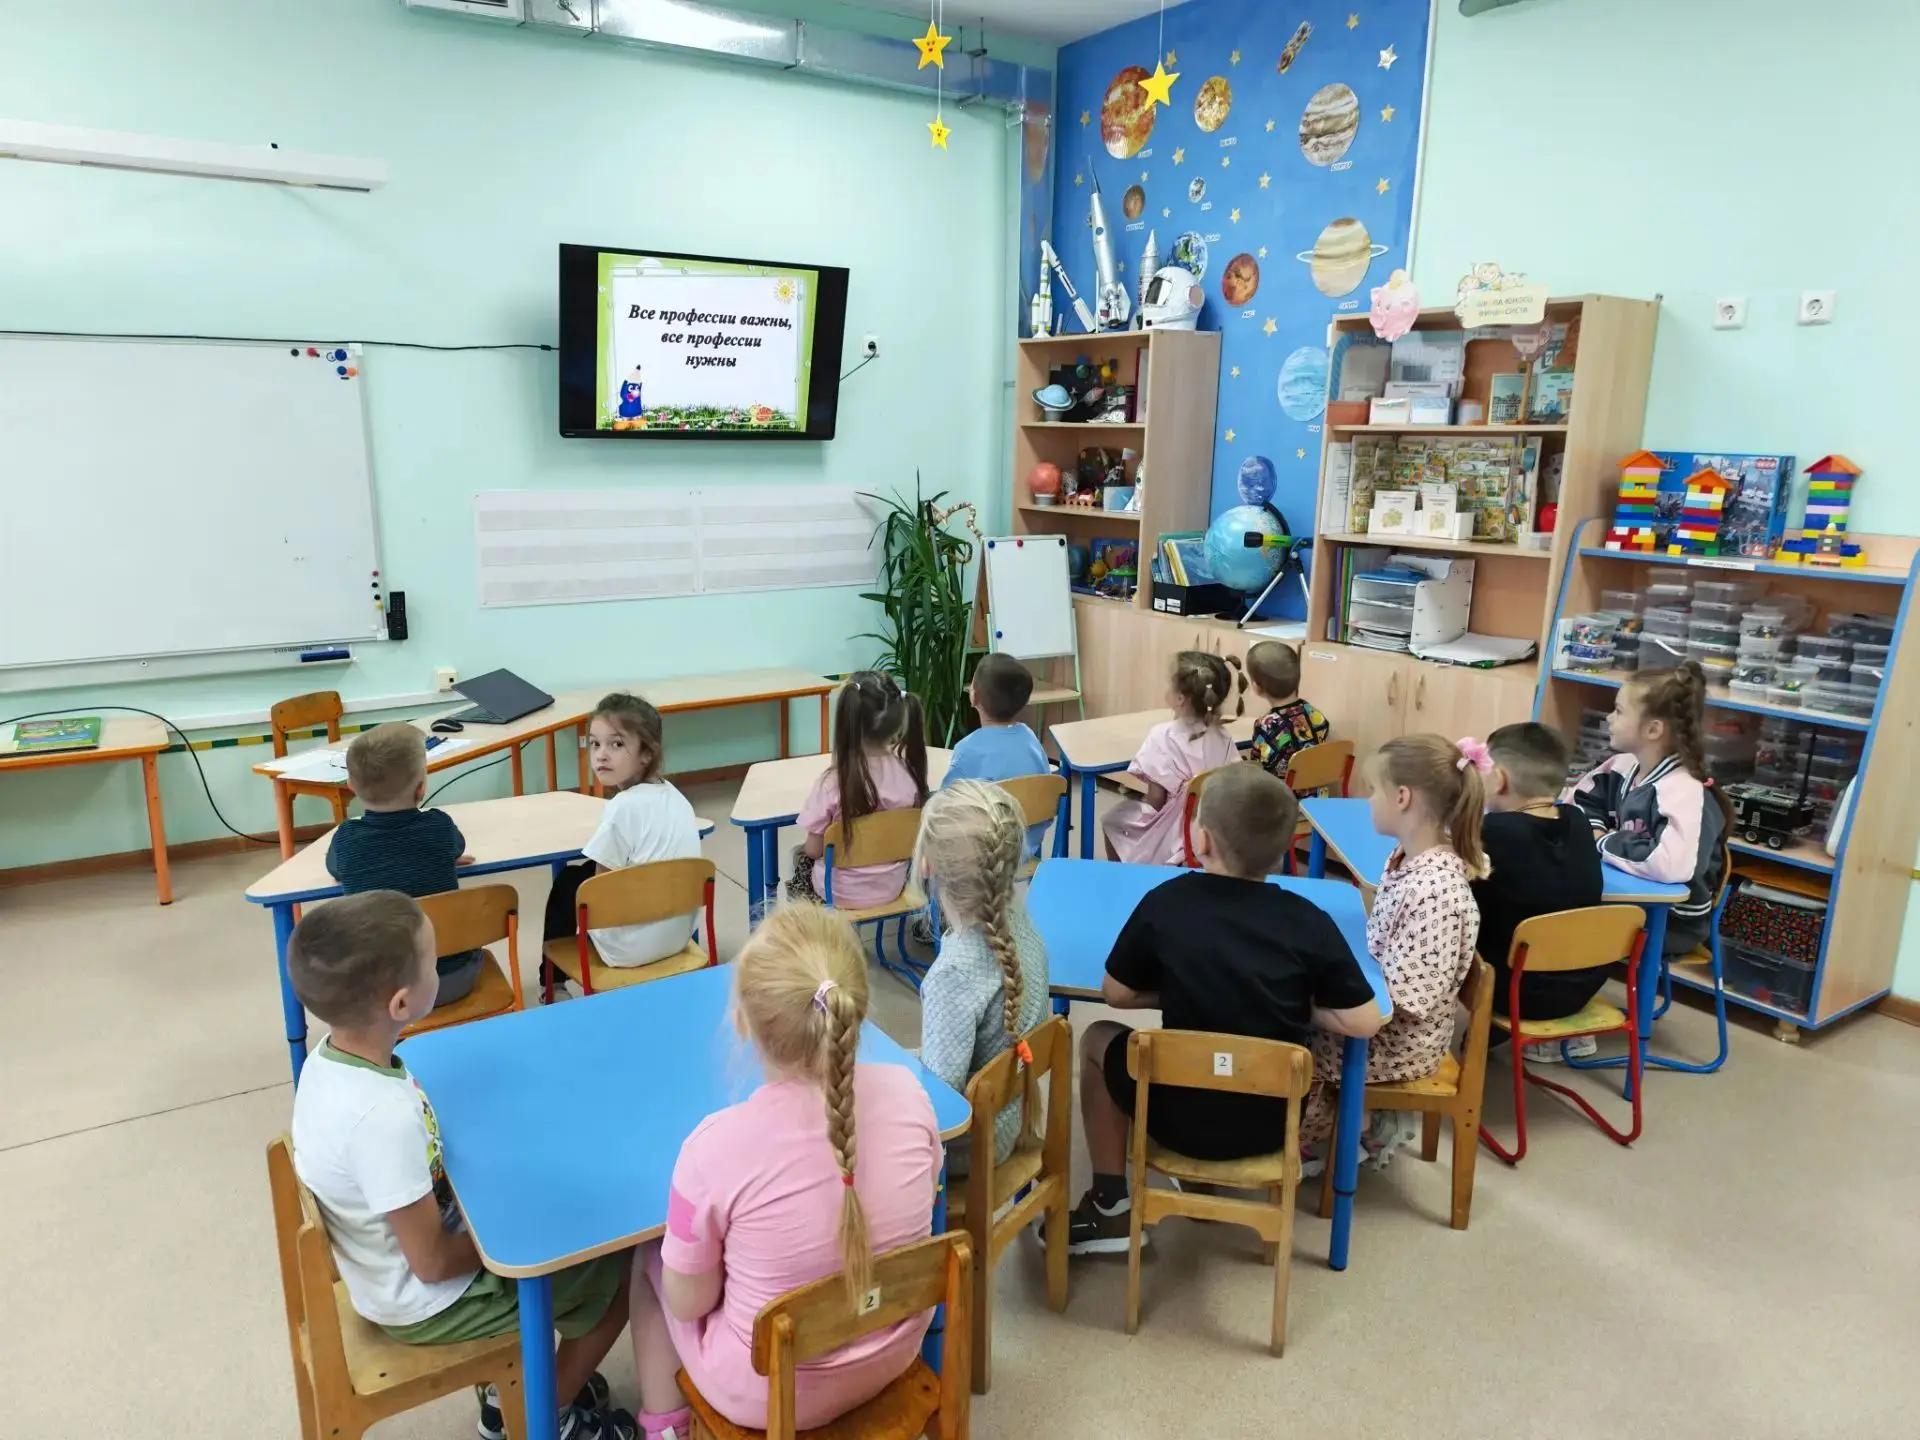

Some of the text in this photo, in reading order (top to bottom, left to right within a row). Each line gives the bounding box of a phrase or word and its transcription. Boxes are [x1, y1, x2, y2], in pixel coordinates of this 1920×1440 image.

[628, 304, 792, 330] Все профессии важны,
[661, 331, 762, 349] все профессии
[685, 354, 737, 369] нужны
[1219, 1056, 1227, 1067] 2
[864, 1295, 874, 1309] 2
